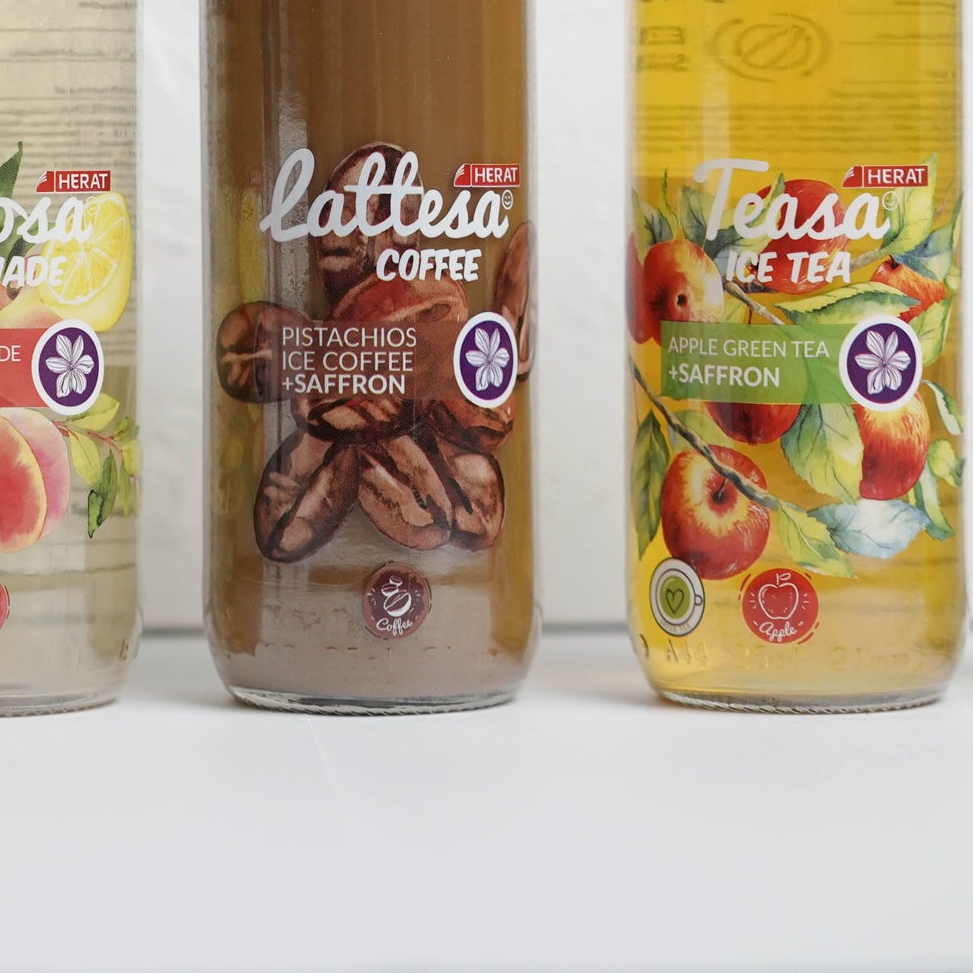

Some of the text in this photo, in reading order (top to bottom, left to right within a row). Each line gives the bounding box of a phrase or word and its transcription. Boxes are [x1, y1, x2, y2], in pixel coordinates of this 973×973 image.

[58, 173, 108, 190] HERAT
[474, 167, 518, 183] HERAT
[867, 168, 925, 184] HERAT
[693, 158, 891, 242] Teasa
[377, 248, 482, 282] COFFEE
[726, 251, 852, 284] ICE TEA
[282, 327, 417, 348] PISTACHIOS
[668, 336, 829, 358] APPLE GREEN TEA
[282, 351, 414, 371] ICE COFFEE
[282, 374, 405, 395] +SAFFRON
[668, 363, 780, 388] +SAFFRON
[376, 618, 413, 636] Coffee
[758, 621, 798, 643] Apple
